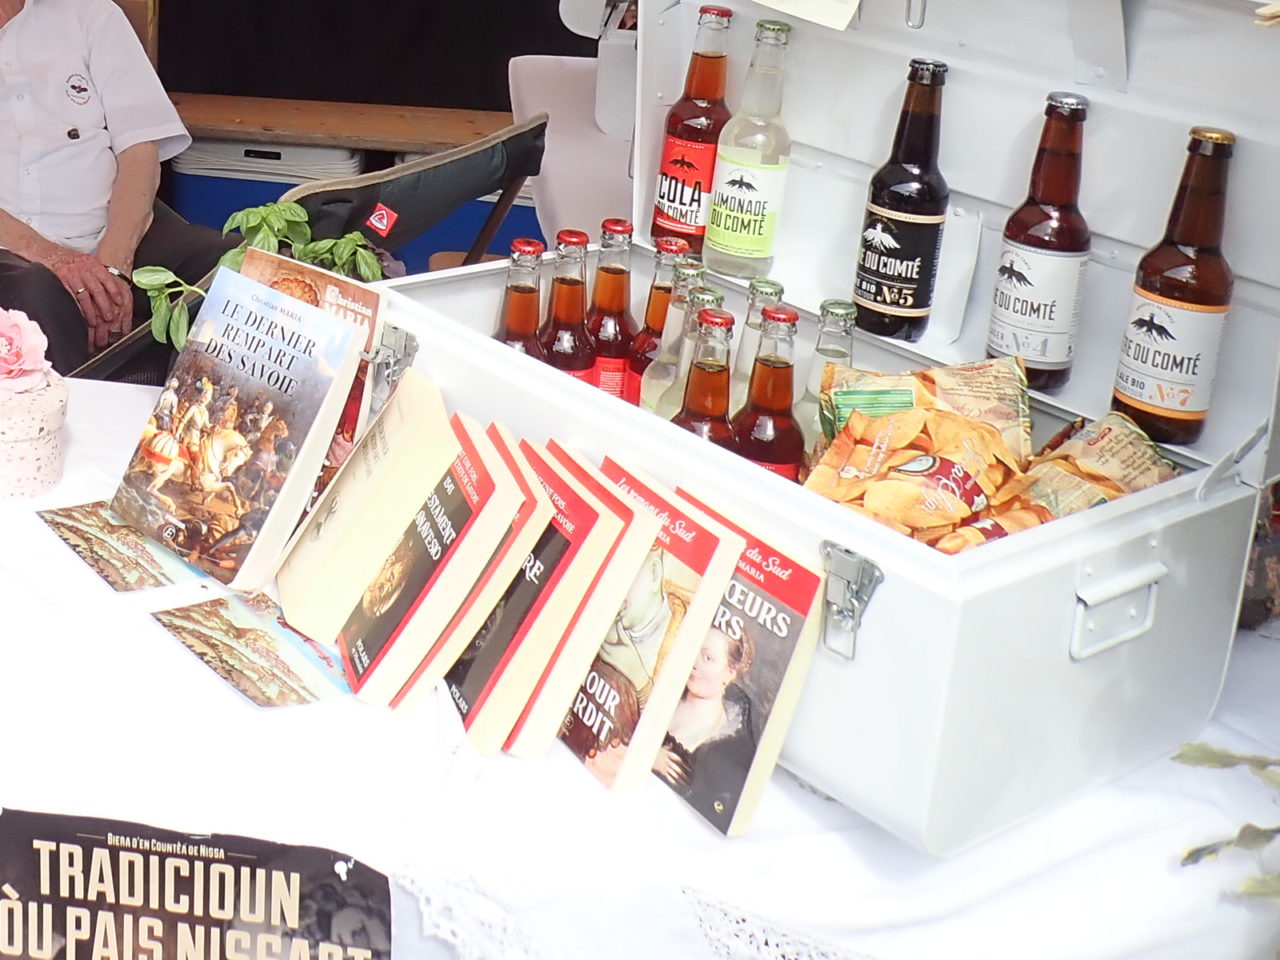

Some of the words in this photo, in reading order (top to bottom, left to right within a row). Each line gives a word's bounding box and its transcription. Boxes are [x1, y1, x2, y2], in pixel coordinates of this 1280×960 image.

[658, 172, 702, 209] COLA
[713, 190, 768, 217] LIMONADE
[666, 204, 700, 225] COMTÉ
[710, 208, 722, 228] DU
[723, 214, 766, 236] COMTÉ
[864, 250, 879, 271] DU
[878, 256, 921, 279] COMTÉ
[323, 284, 373, 317] Christian
[999, 291, 1011, 311] DU
[1012, 297, 1056, 321] COMTÉ
[221, 298, 244, 322] LE
[243, 309, 317, 358] DERNIER
[221, 322, 299, 371] REMPART
[1133, 342, 1150, 364] DU
[1151, 350, 1201, 376] COMTÉ
[204, 336, 237, 365] DES
[236, 354, 299, 398] SAVOIE
[427, 490, 457, 546] ESTAMENT
[669, 519, 697, 544] Sud
[737, 559, 765, 584] MARIA
[745, 547, 763, 565] du
[761, 555, 793, 582] Sud
[450, 683, 469, 714] POLARS
[199, 843, 225, 860] NISSA
[32, 839, 301, 929] TRADICIOUN
[66, 905, 164, 960] PAIS
